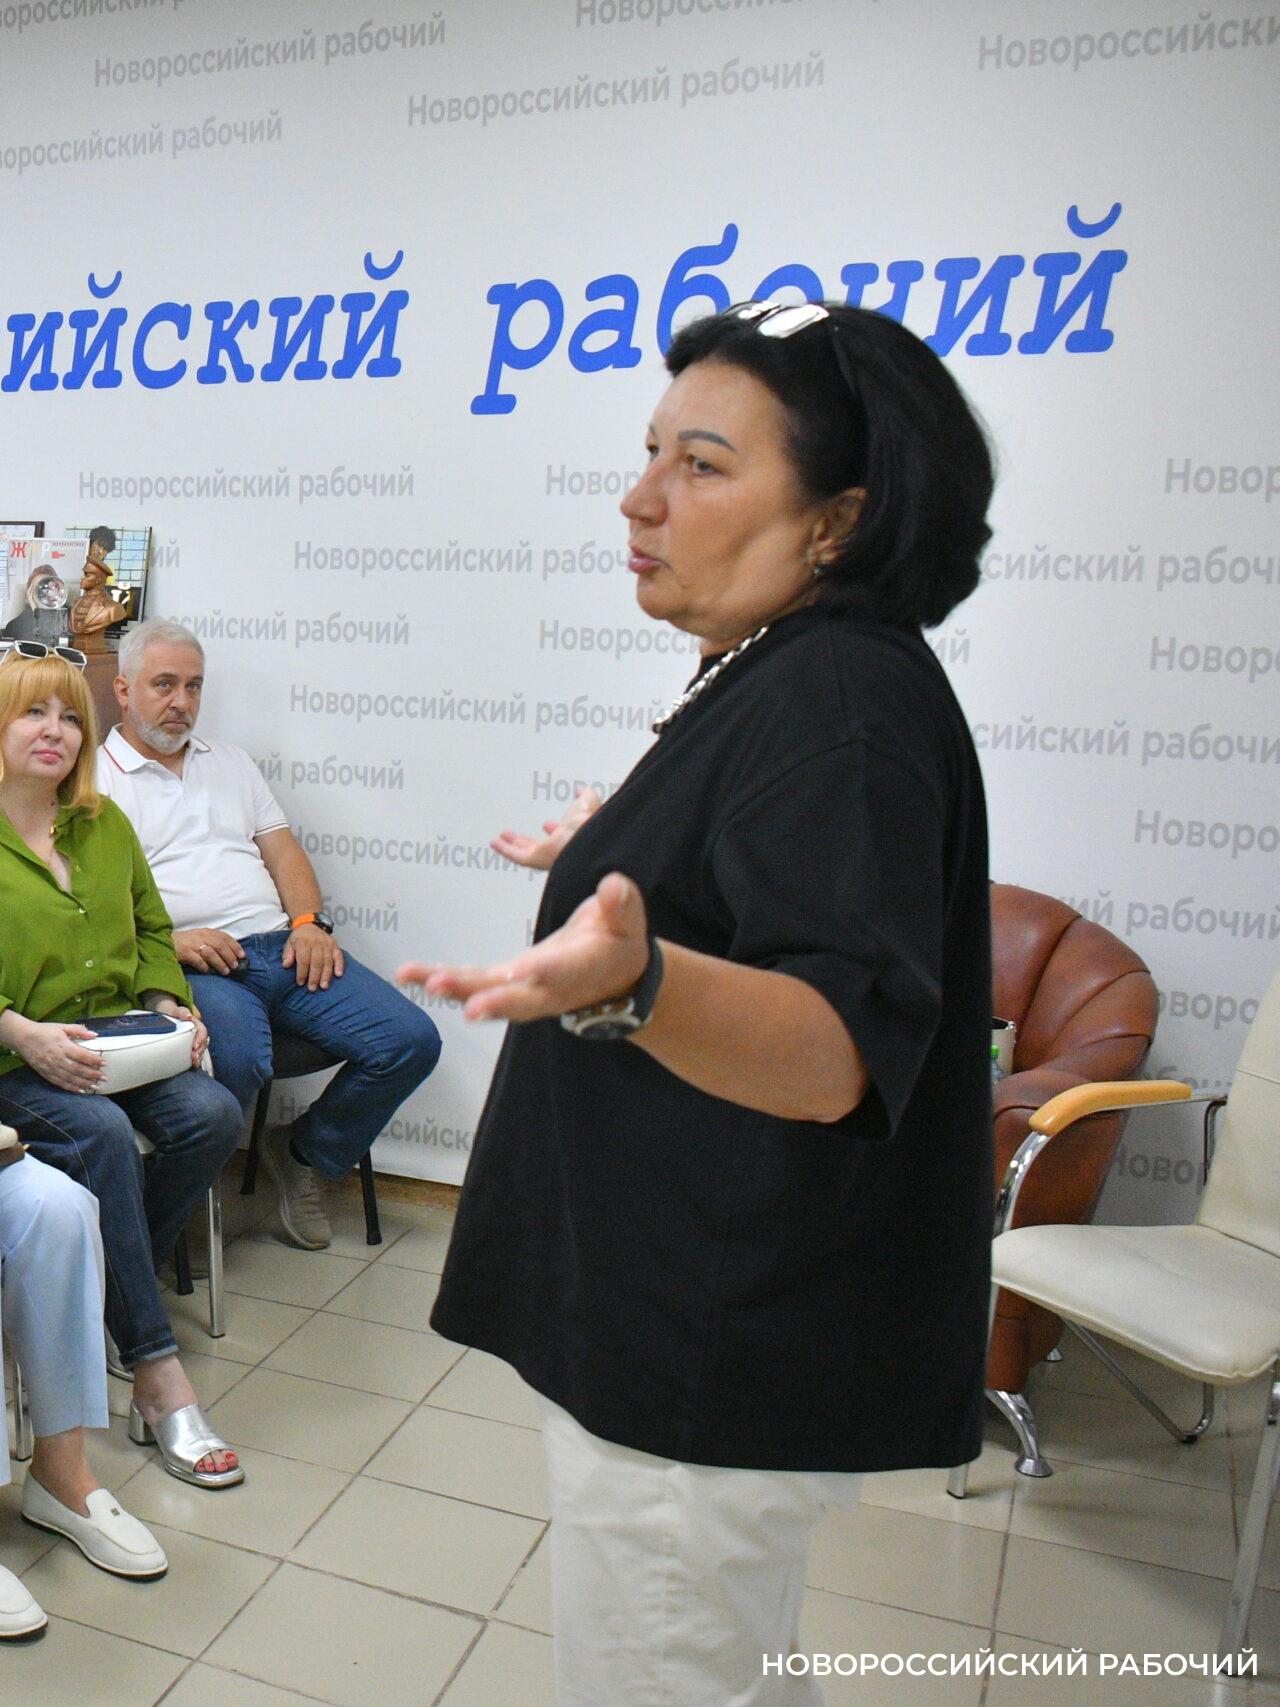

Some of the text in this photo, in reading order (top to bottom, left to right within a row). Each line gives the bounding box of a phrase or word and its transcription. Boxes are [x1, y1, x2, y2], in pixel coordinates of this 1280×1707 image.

[94, 13, 446, 88] Новороссийский рабочий
[408, 50, 827, 127] Новороссийский рабочий
[172, 109, 283, 159] рабочий
[78, 465, 415, 505] Новороссийский рабочий
[294, 540, 631, 581] Новороссийский рабоч
[1156, 545, 1280, 591] рабоч
[295, 612, 410, 648] рабочий
[290, 684, 525, 725] Новороссийский
[290, 755, 404, 790] рабочий
